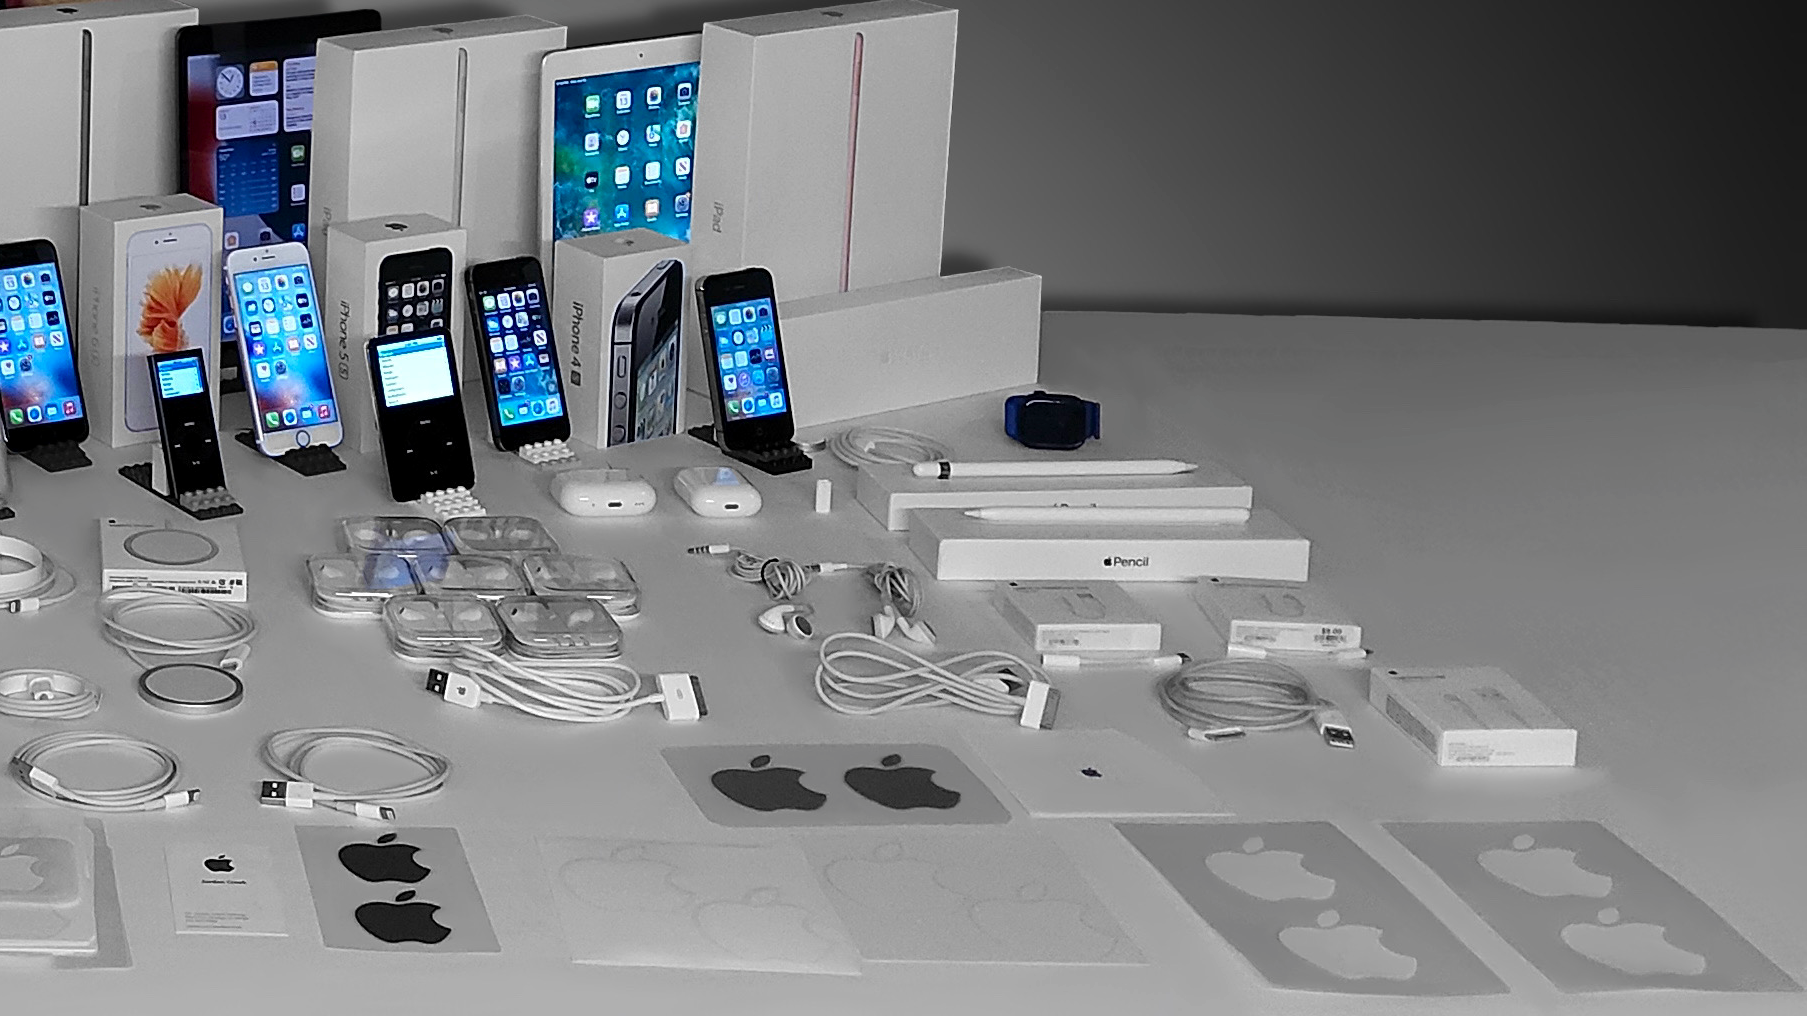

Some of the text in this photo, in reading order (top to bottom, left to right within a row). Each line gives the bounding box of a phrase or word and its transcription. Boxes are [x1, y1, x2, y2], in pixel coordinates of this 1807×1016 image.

[619, 96, 628, 106] 13
[712, 200, 724, 234] iPad
[339, 300, 351, 350] iPhone
[571, 301, 584, 354] iPhone
[1113, 555, 1149, 568] Pencil
